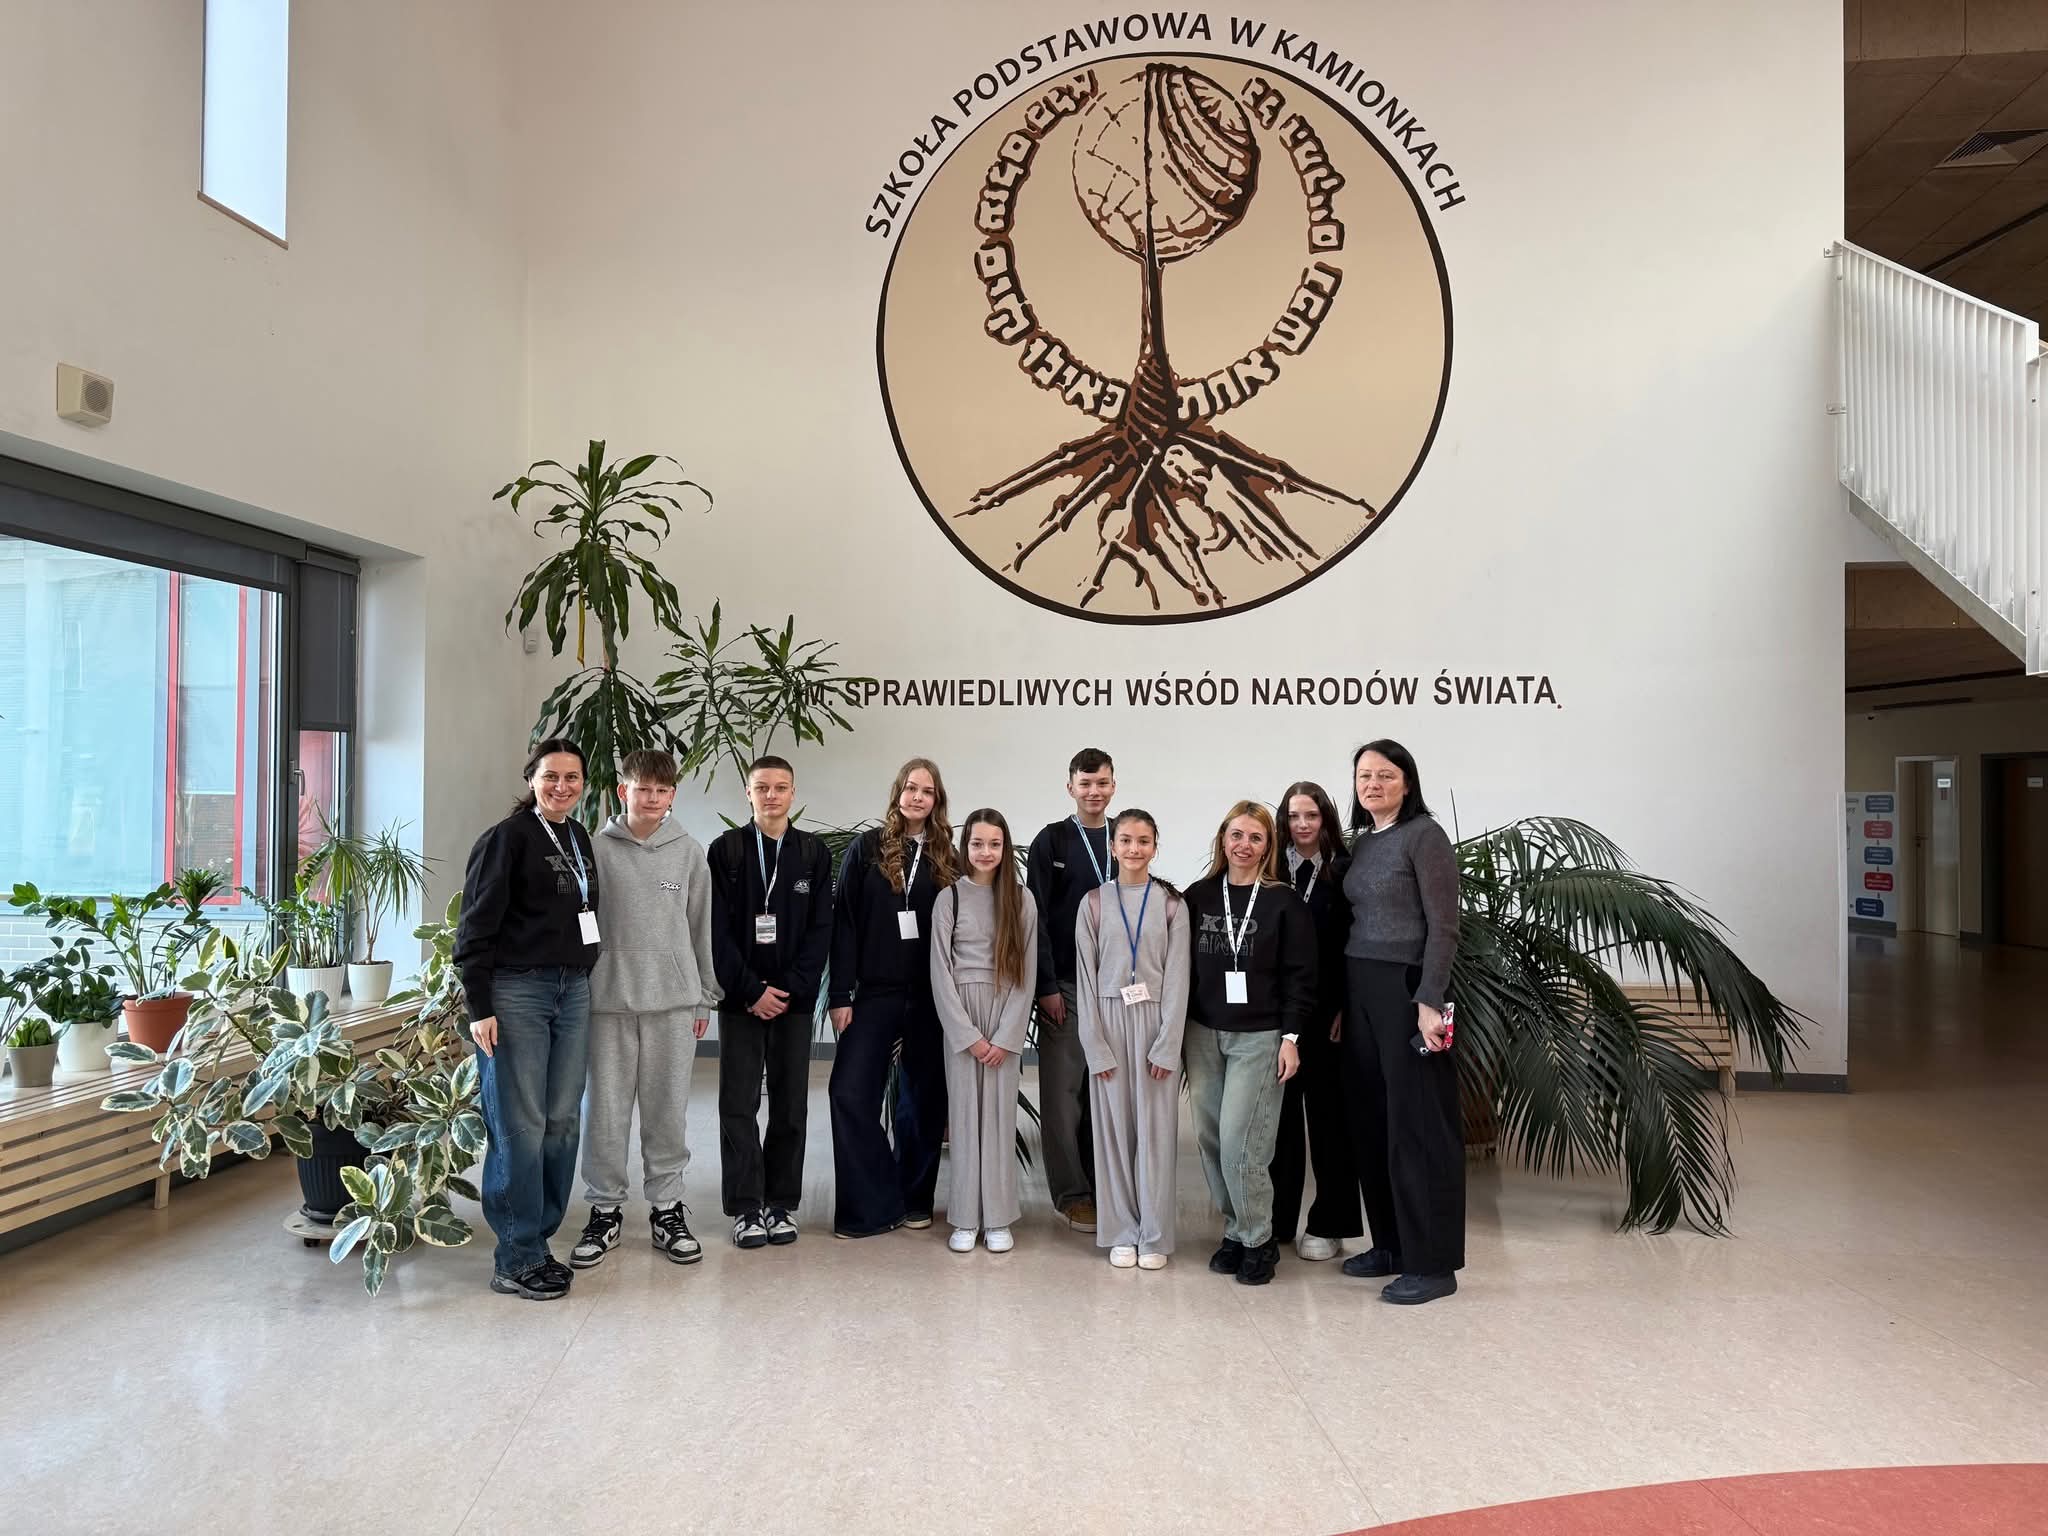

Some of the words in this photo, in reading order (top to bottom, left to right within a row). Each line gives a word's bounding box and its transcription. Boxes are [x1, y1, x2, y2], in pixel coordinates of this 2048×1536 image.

[865, 114, 959, 239] SZKOŁA
[952, 11, 1212, 118] PODSTAWOWA
[1230, 16, 1267, 48] W
[1270, 28, 1466, 212] KAMIONKACH
[845, 678, 1112, 707] SPRAWIEDLIWYCH
[1125, 670, 1239, 707] WŚRÓD
[1252, 668, 1419, 707] NARODÓW
